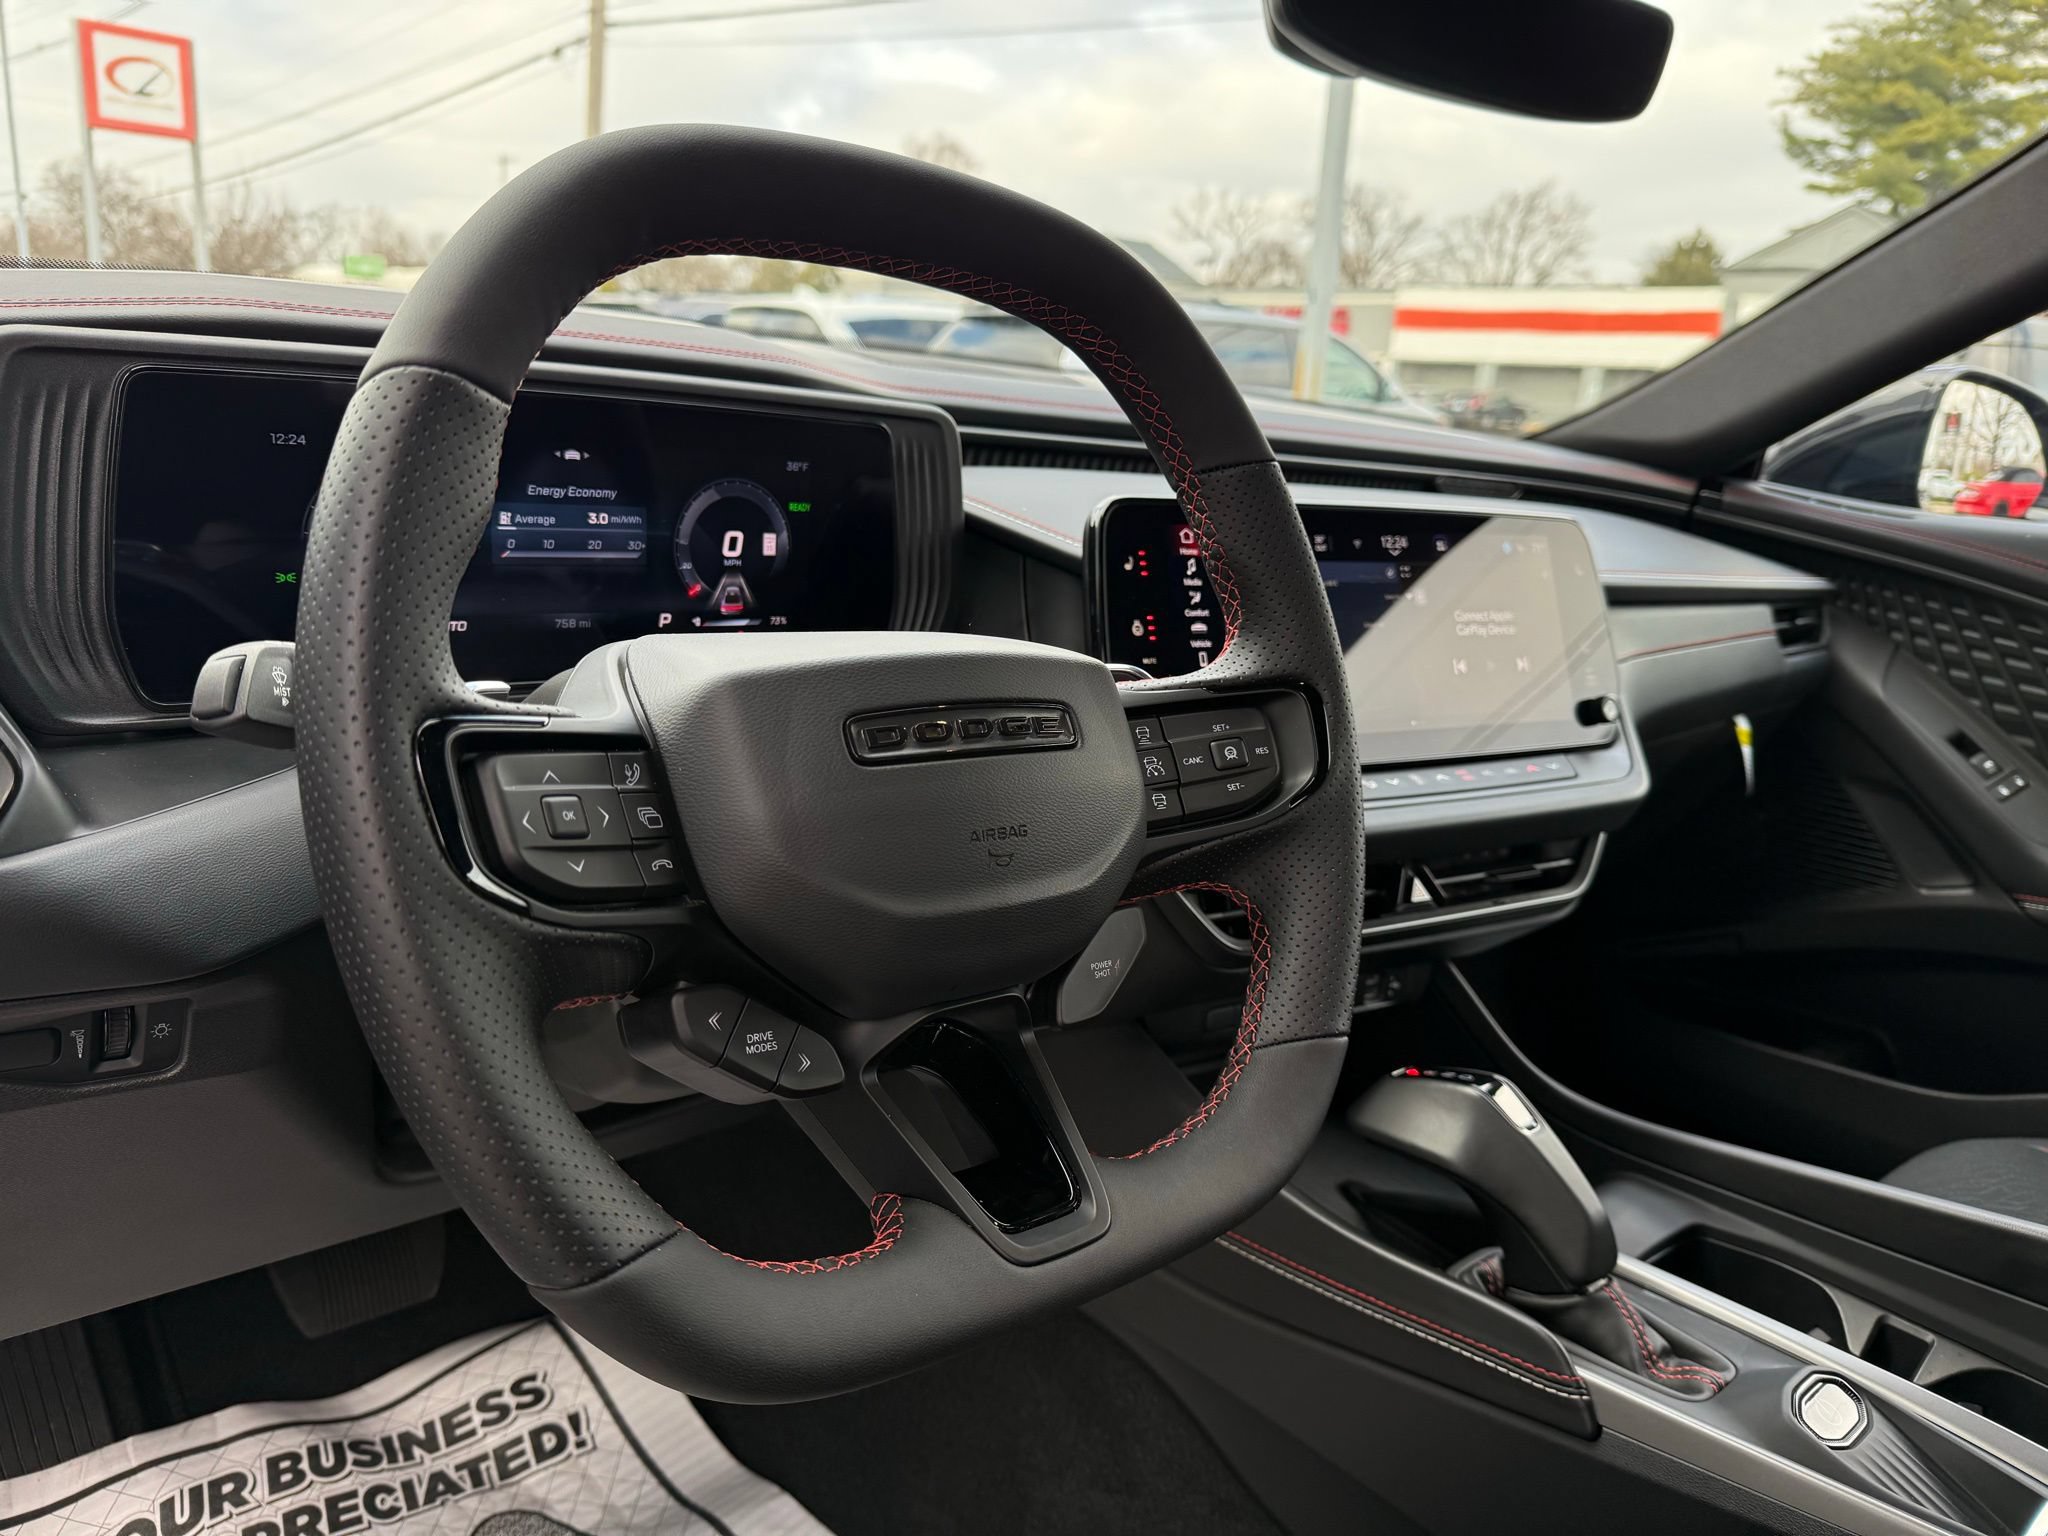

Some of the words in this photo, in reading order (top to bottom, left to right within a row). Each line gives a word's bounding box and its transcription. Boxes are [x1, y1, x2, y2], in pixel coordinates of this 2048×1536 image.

[270, 433, 306, 446] 12:24
[528, 485, 566, 498] Energy
[568, 486, 617, 500] Economy
[788, 503, 811, 512] READY
[515, 514, 556, 528] Average
[588, 512, 608, 524] 3.0
[610, 515, 642, 525] mi/kWh
[507, 539, 516, 549] 0
[543, 540, 555, 549] 10
[588, 540, 602, 550] 20
[722, 530, 744, 557] 0
[1380, 534, 1409, 549] 12:24
[724, 559, 742, 567] MPH
[1184, 608, 1211, 618] Comfort
[1454, 609, 1488, 622] Connect
[555, 619, 576, 629] 758
[578, 618, 591, 629] mi
[658, 613, 672, 628] P
[769, 616, 788, 626] 73%
[1456, 624, 1486, 637] CarPlay
[273, 687, 291, 697] MIST
[861, 716, 1065, 750] DODGE
[1212, 724, 1230, 732] SET+
[1183, 756, 1204, 766] CANC
[562, 811, 576, 821] OK
[969, 824, 1029, 843] AIRBAG
[1090, 959, 1112, 970] POWER
[1094, 969, 1111, 979] SHOT
[746, 1030, 774, 1043] DRIVE
[745, 1041, 778, 1055] MODES
[266, 1373, 548, 1495] BUSINESS
